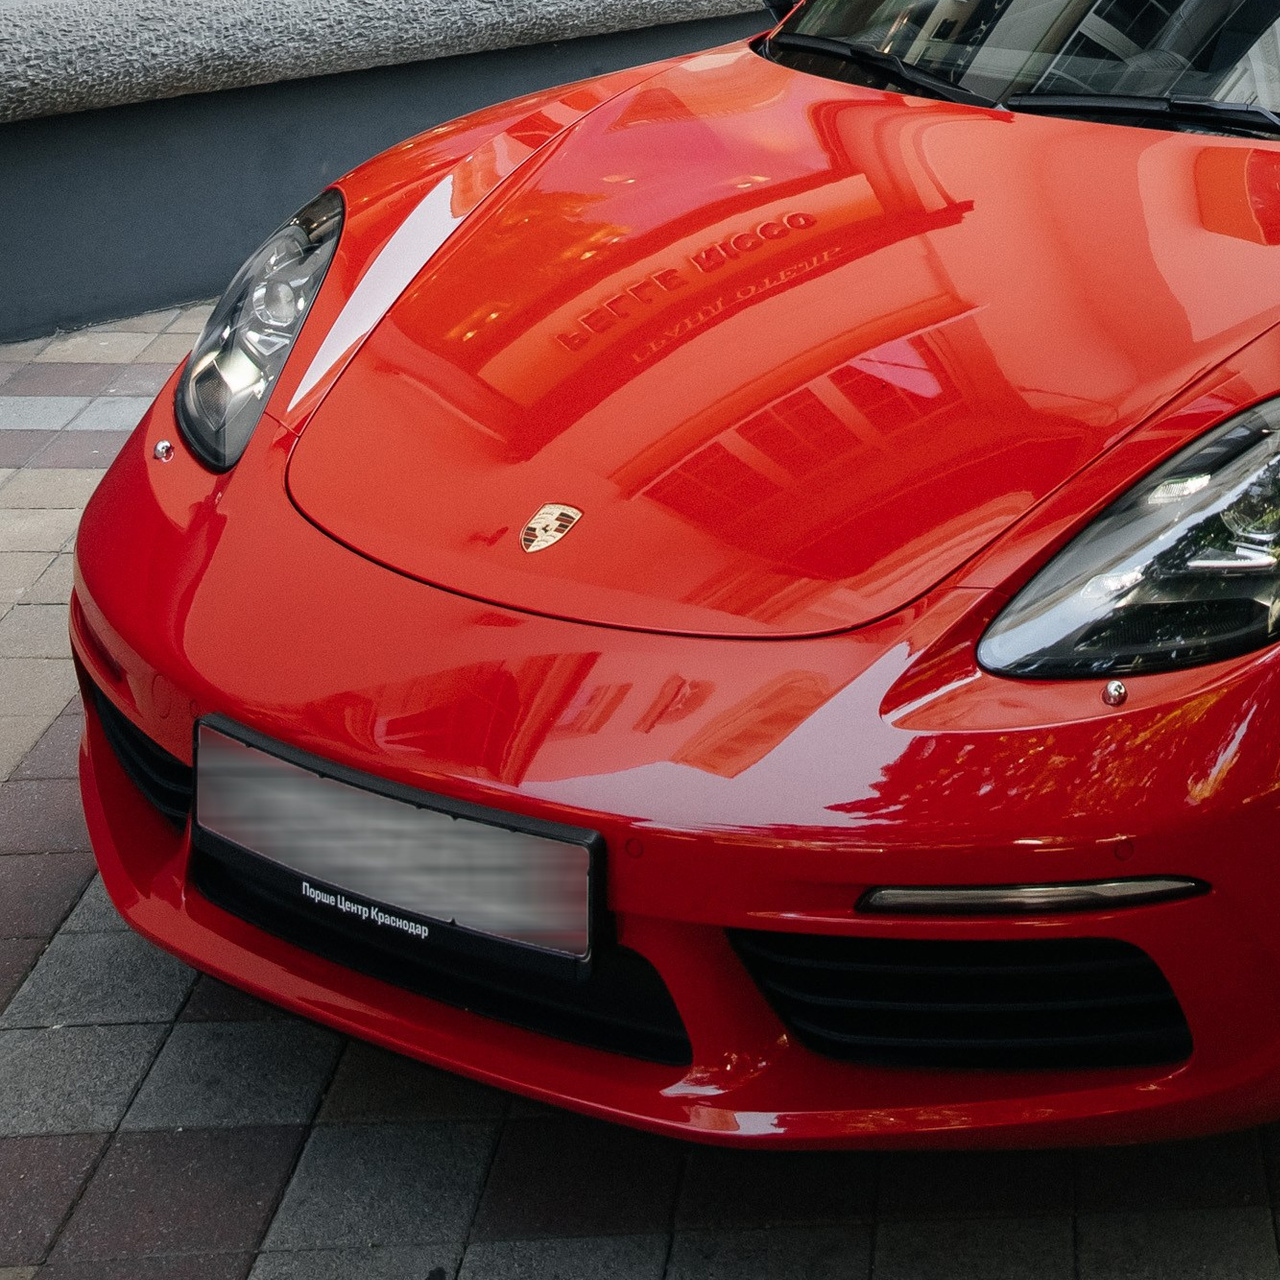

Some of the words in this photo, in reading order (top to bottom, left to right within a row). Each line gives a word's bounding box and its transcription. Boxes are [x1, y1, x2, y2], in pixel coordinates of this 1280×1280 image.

[302, 881, 336, 906] Порше
[337, 894, 369, 920] Центр
[370, 906, 429, 939] Краснодар
